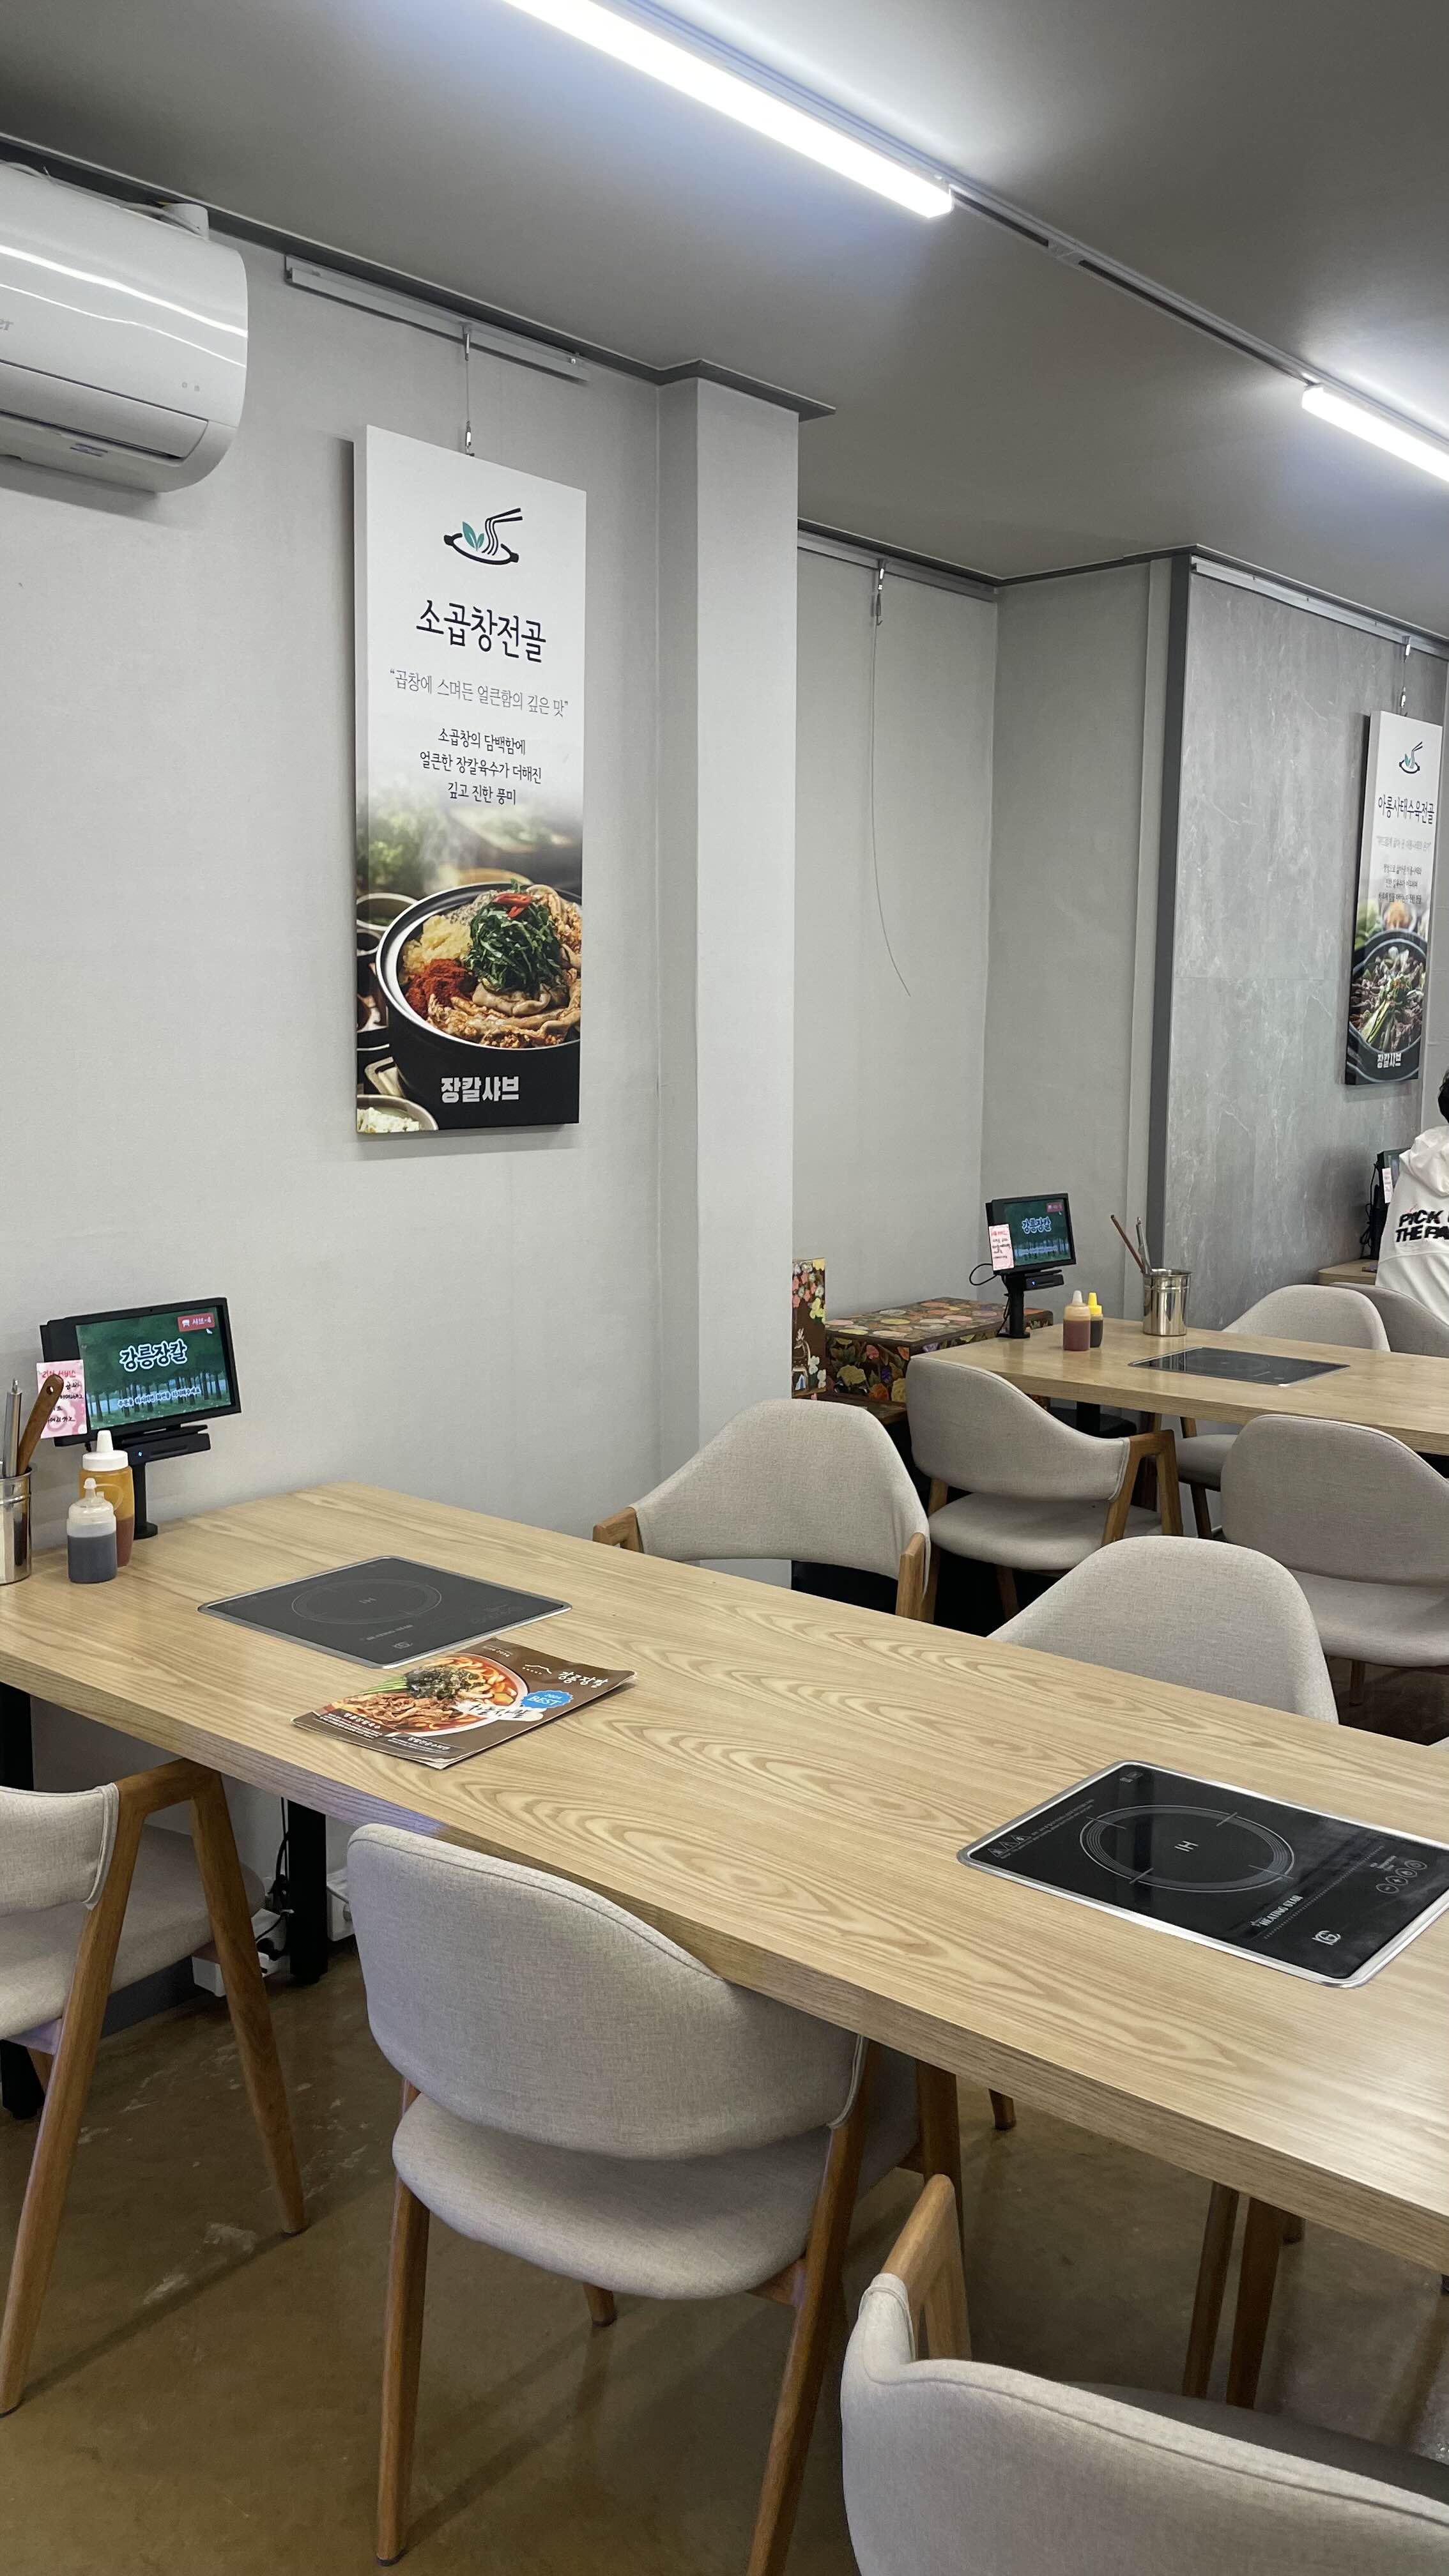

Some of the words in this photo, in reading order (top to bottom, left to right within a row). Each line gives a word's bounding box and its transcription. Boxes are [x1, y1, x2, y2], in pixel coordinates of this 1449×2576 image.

[416, 599, 546, 663] 소곱창전골
[437, 679, 473, 702] 스며든
[477, 685, 523, 710] 얼큰함의
[527, 694, 549, 715] 깊은
[438, 728, 480, 748] 소곱창의
[484, 734, 525, 755] 담백함에
[420, 751, 453, 772] 얼큰한
[456, 756, 510, 778] 장칼육수가
[512, 764, 541, 784] 더해진
[448, 781, 469, 799] 깊고
[472, 785, 493, 803] 진한
[496, 788, 516, 805] 풍미
[1378, 794, 1434, 824] 아롱사태수육전골
[1377, 1052, 1402, 1068] 장칼샤브
[441, 1076, 519, 1103] 장칼샤브
[1022, 1216, 1051, 1234] 강릉장칼
[1399, 1209, 1444, 1227] PICK
[1395, 1225, 1423, 1242] THE
[119, 1338, 188, 1372] 강릉장칼
[558, 1671, 609, 1689] 강릉장칼
[528, 1695, 562, 1706] BEST
[1174, 1840, 1199, 1852] IH
[1259, 1906, 1289, 1926] HEATING
[1283, 1894, 1303, 1908] STAR
